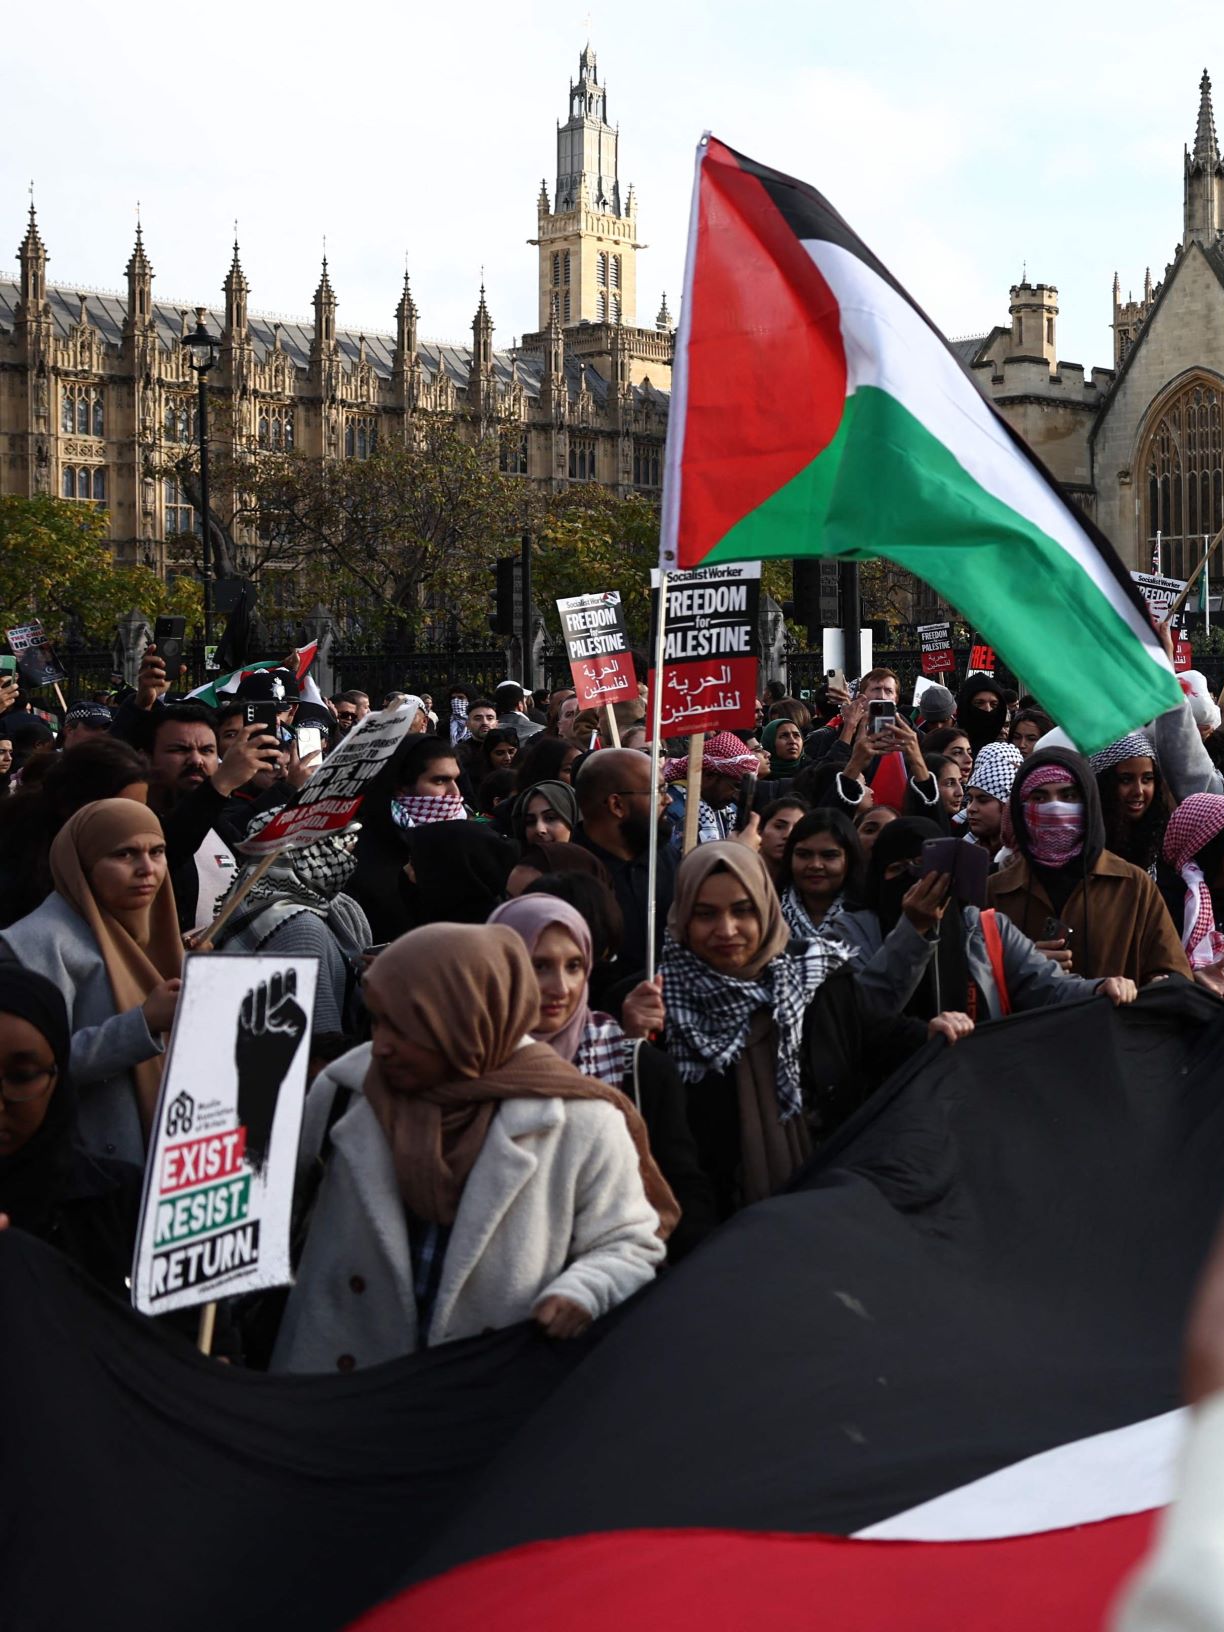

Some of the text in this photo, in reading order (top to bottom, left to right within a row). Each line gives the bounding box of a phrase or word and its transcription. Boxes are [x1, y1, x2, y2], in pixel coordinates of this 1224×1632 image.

[667, 567, 743, 583] Socialist Worker
[1138, 575, 1181, 589] Socialist Worker
[566, 600, 590, 609] Socialist
[565, 608, 618, 632] FREEDOM
[695, 616, 711, 628] for
[589, 628, 599, 637] for
[921, 630, 948, 641] FREEDOM
[14, 640, 28, 649] IN
[568, 633, 626, 659] PALESTINE
[921, 640, 951, 652] PALESTINE
[583, 660, 619, 680] الحرية
[667, 665, 731, 695] الحرية
[584, 675, 628, 699] لفلسطين
[660, 691, 741, 725] لفلسطين
[366, 750, 379, 759] TO
[298, 785, 321, 805] ON
[162, 1134, 244, 1189] EXIST.
[155, 1180, 248, 1244] RESIST.
[150, 1226, 258, 1297] RETURN.
